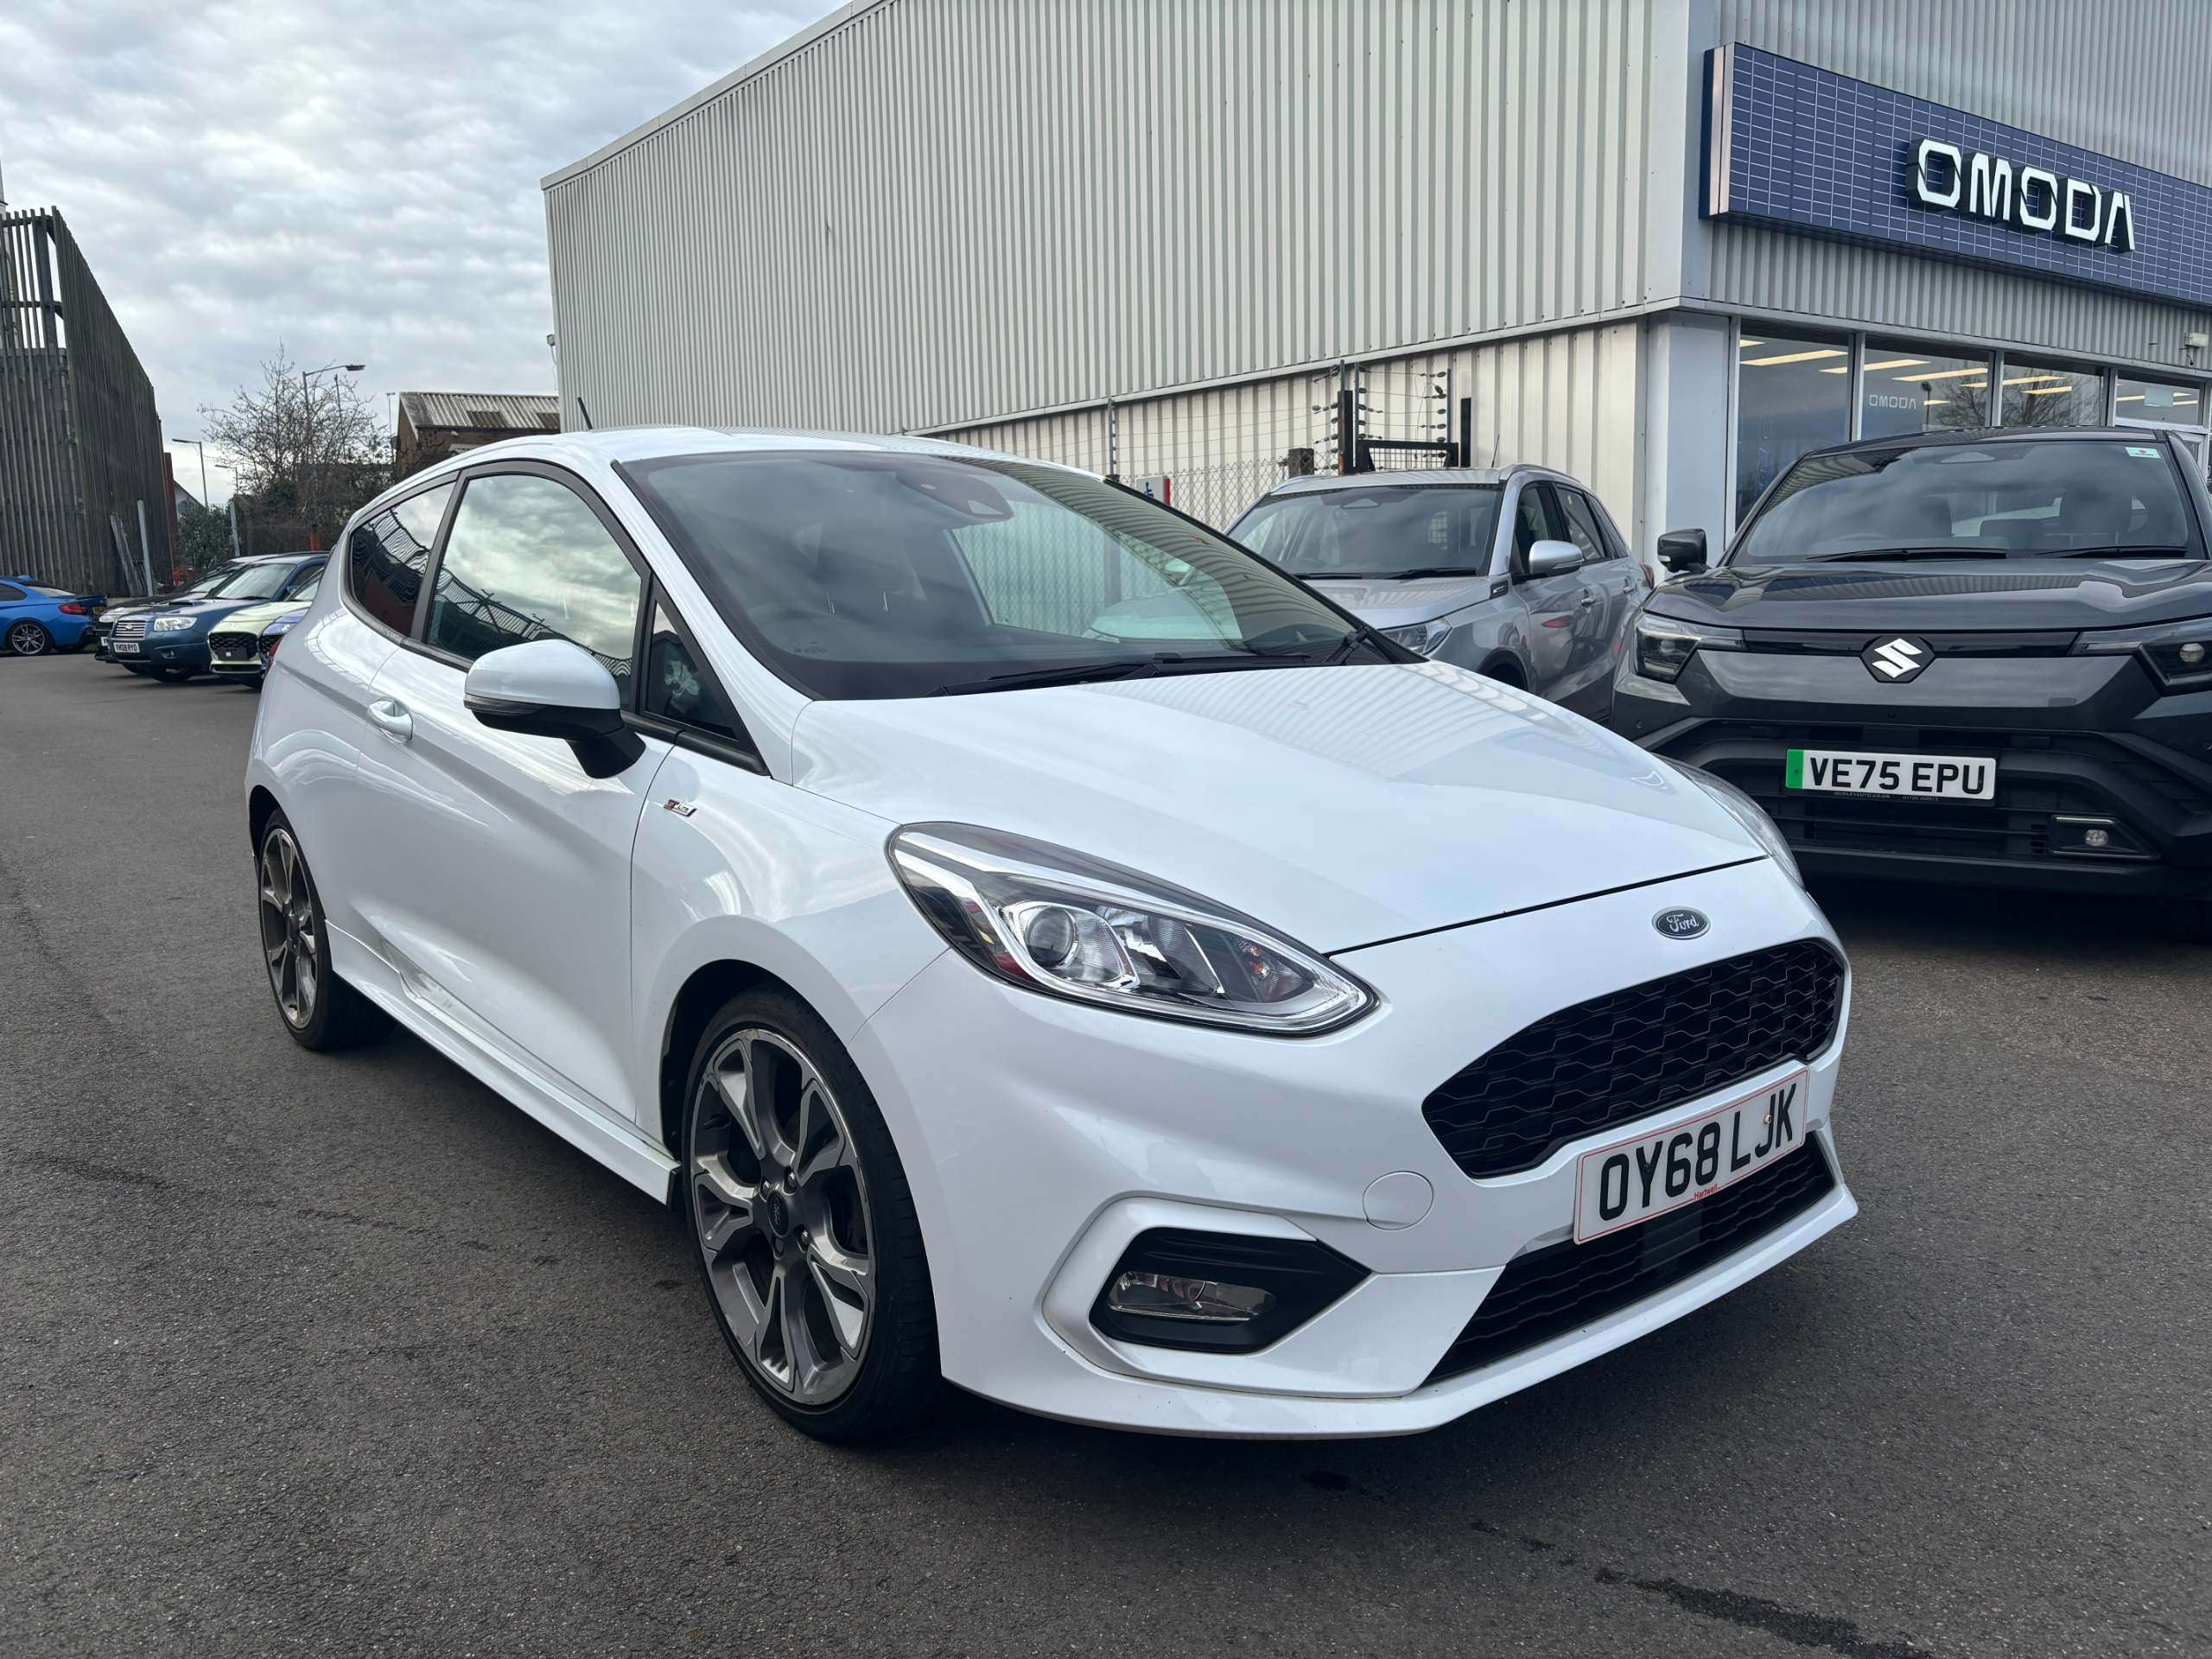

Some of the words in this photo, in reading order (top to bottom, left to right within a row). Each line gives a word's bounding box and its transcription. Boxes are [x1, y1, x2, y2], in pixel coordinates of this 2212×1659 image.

[1917, 138, 2135, 250] OMODA
[1869, 394, 1916, 410] OMODA
[1810, 757, 1900, 791] VE75
[1911, 762, 1985, 795] EPU
[1666, 913, 1700, 932] Ford
[1599, 1122, 1720, 1221] OY68
[1731, 1083, 1796, 1173] LJK
[1694, 1183, 1718, 1200] Hartwell
